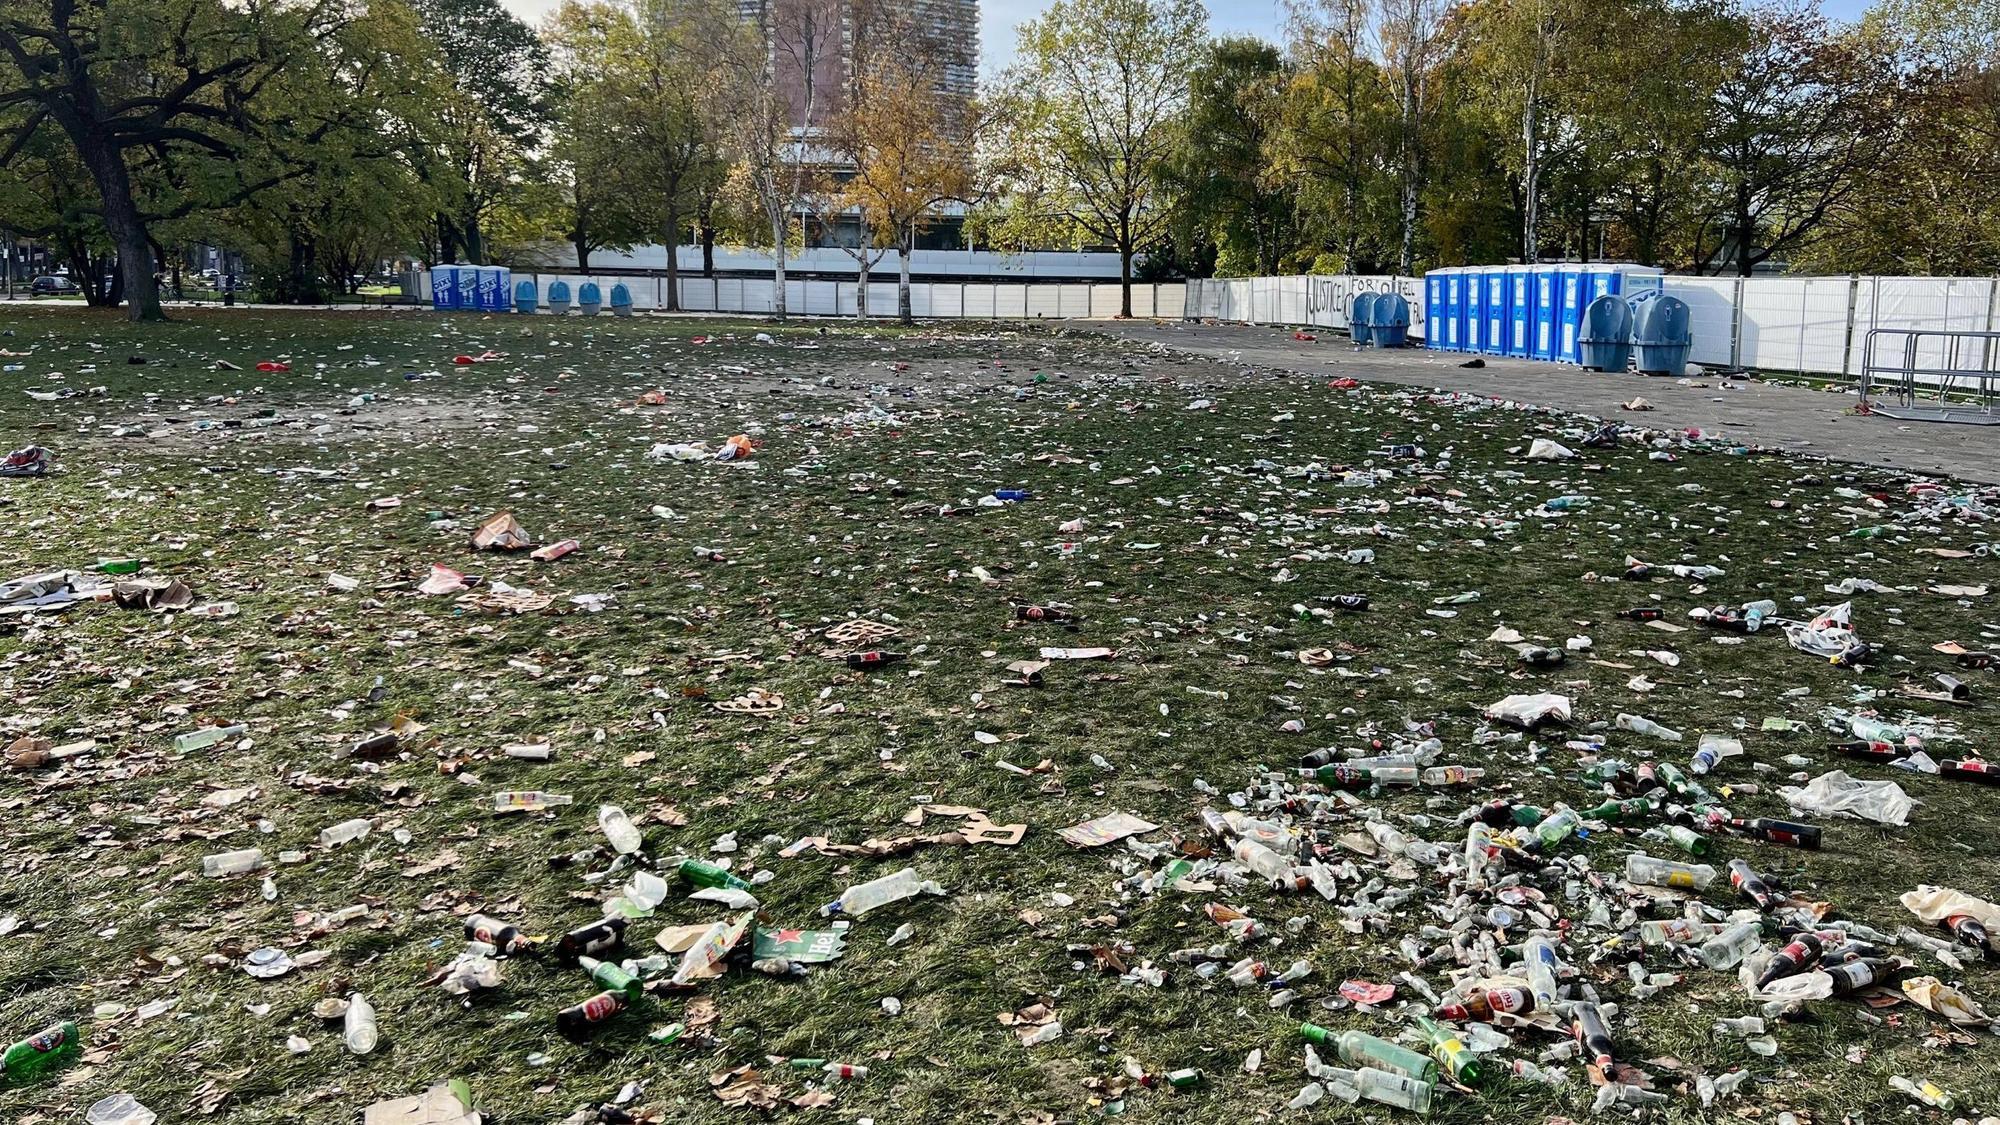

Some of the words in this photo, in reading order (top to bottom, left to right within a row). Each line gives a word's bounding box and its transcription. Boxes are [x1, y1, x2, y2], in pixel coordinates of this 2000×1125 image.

[1309, 278, 1342, 314] JUSTICE
[1352, 278, 1374, 291] FOR
[808, 932, 836, 955] Hei
